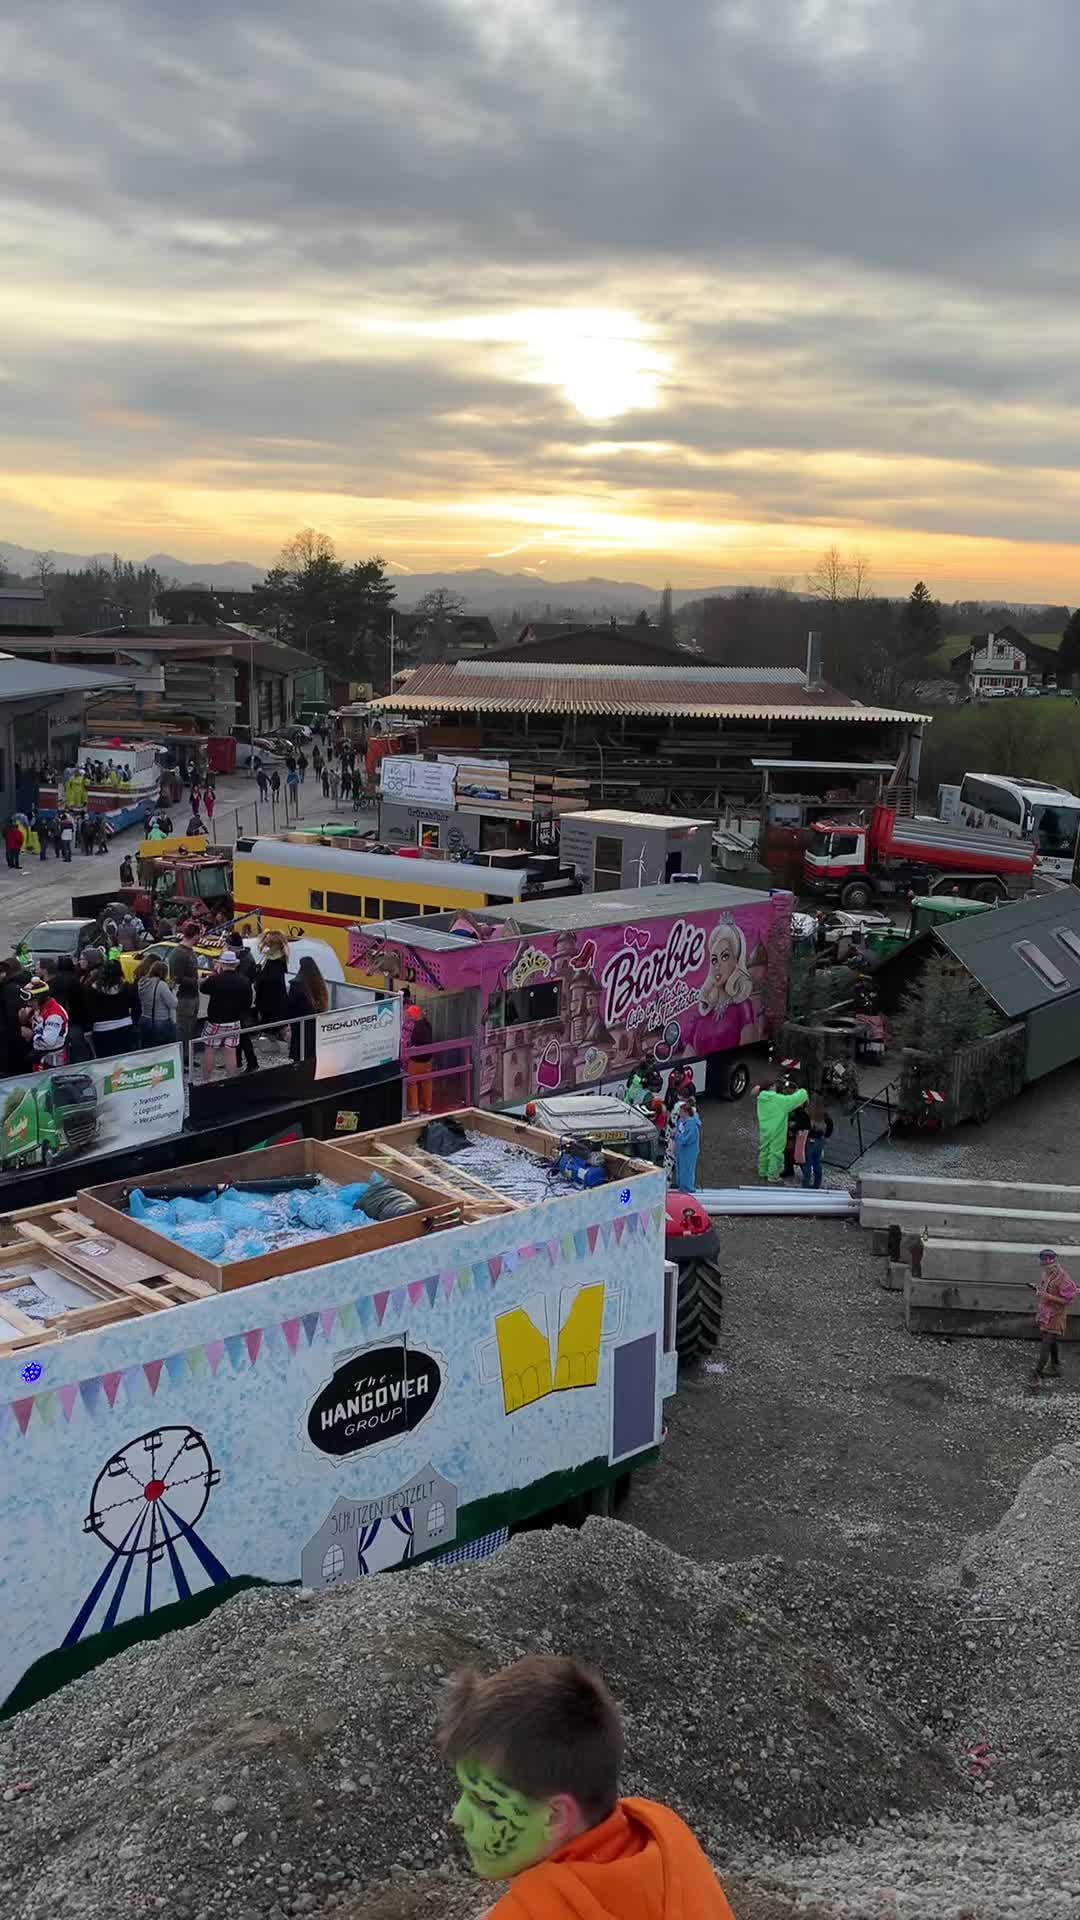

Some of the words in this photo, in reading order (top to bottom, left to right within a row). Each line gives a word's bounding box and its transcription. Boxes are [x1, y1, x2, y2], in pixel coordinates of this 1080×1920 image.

[602, 920, 706, 1028] Barbie
[320, 1014, 378, 1033] TSCHUMPER
[354, 1374, 390, 1393] The
[320, 1373, 430, 1432] HANGOVER
[344, 1406, 403, 1437] GROUP
